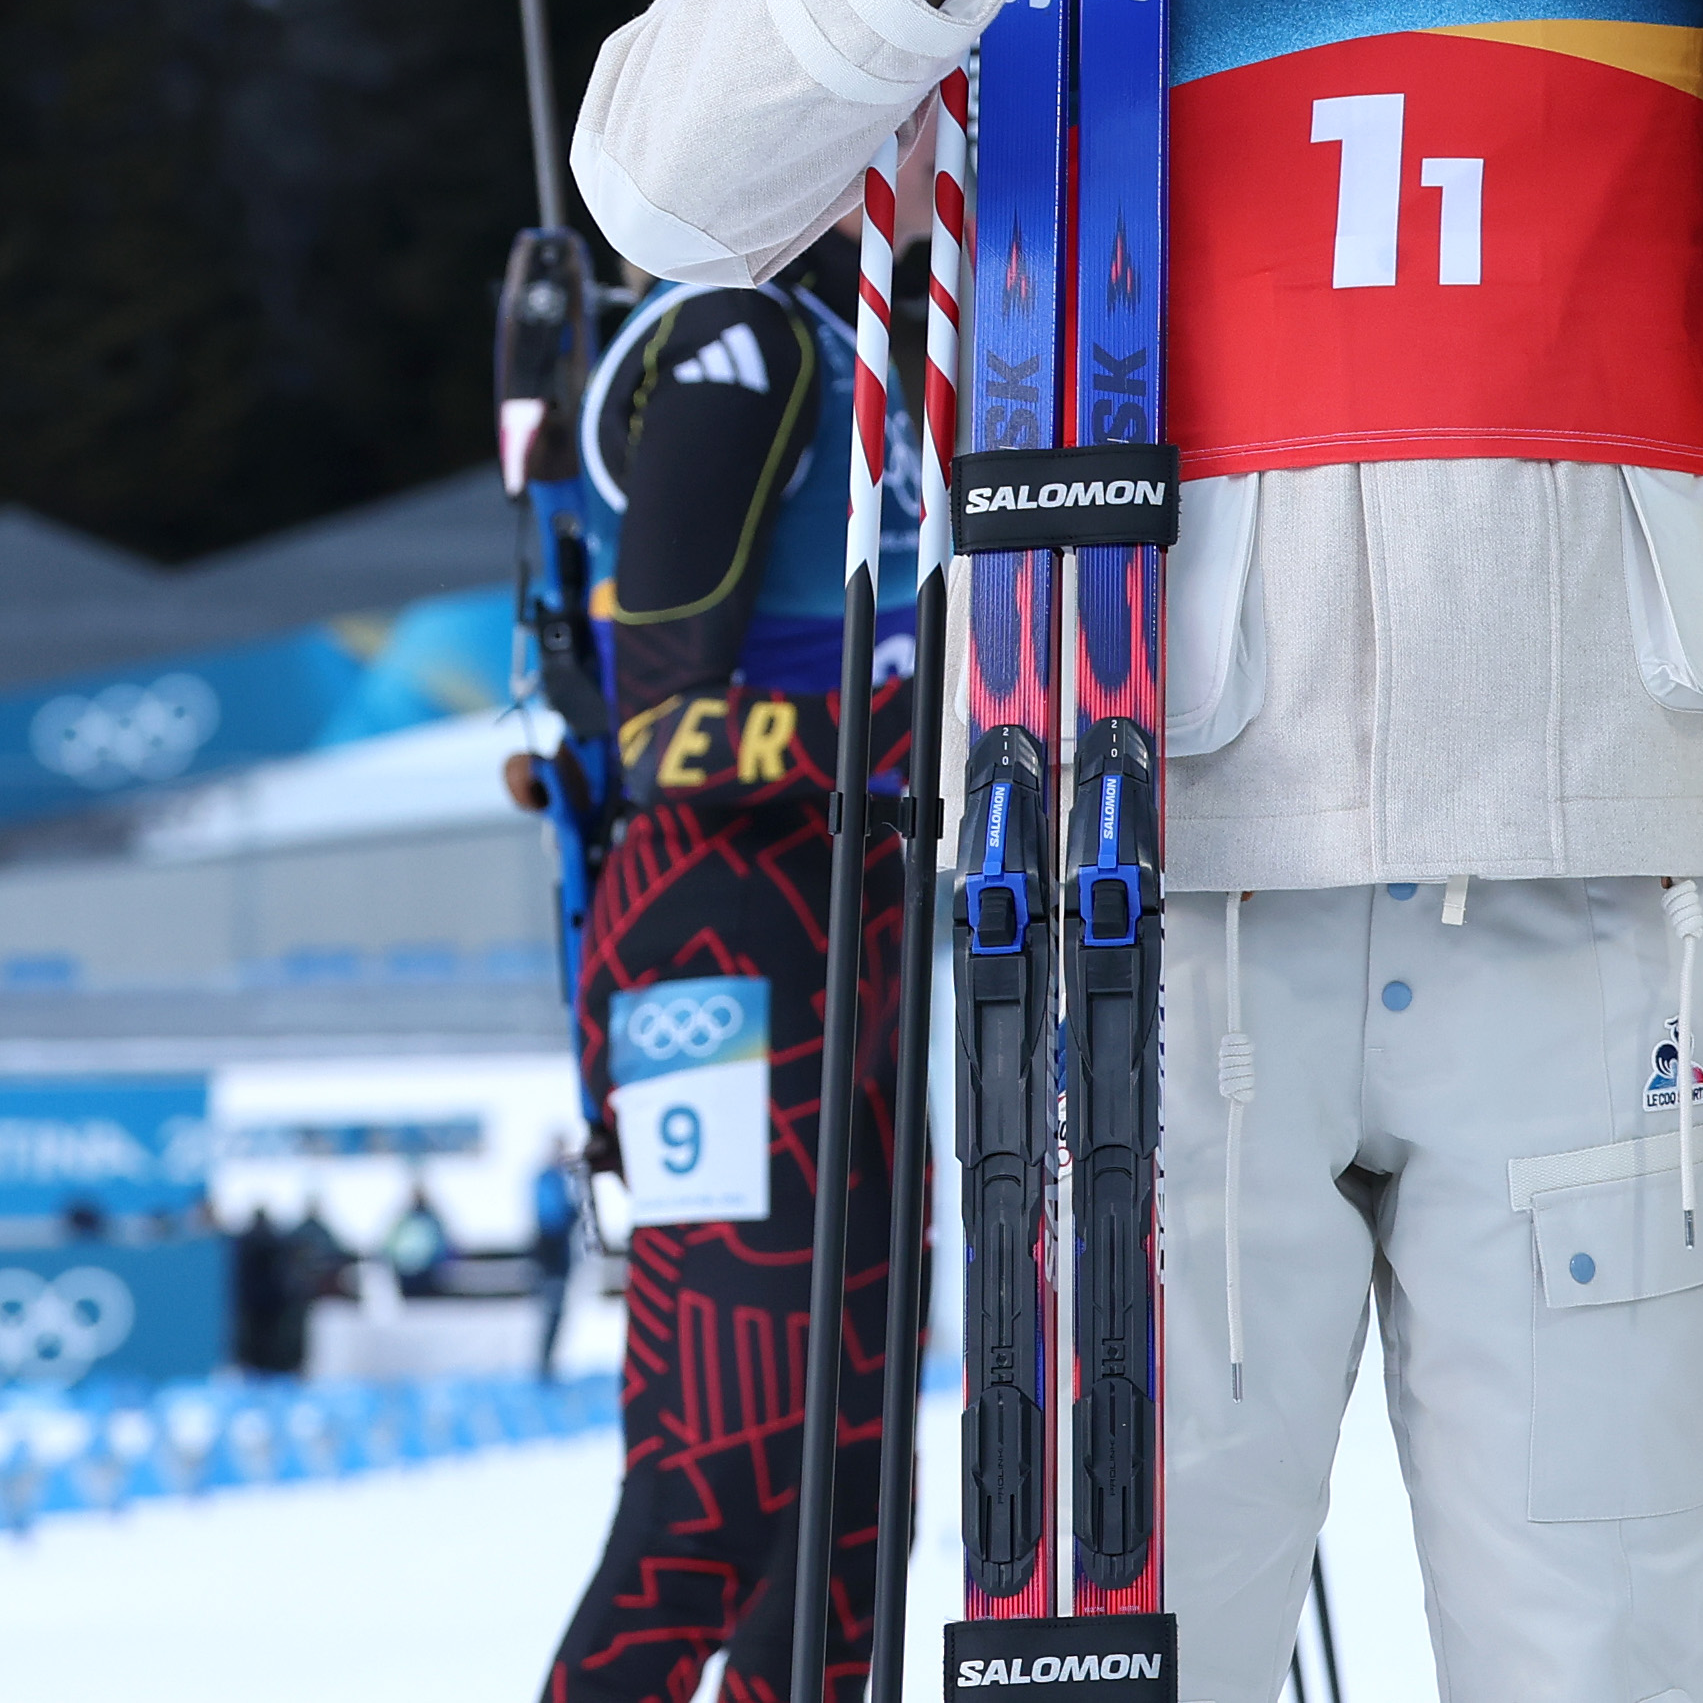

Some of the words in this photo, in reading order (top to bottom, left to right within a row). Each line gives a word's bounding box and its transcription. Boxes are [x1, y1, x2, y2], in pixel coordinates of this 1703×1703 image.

[964, 479, 1166, 515] SALOMON
[989, 786, 1006, 848] SALOMON
[1104, 778, 1117, 840] SALOMON
[1647, 1093, 1659, 1107] LE
[1659, 1092, 1676, 1106] COQ
[659, 1103, 703, 1175] 9
[957, 1652, 1163, 1688] SALOMON
